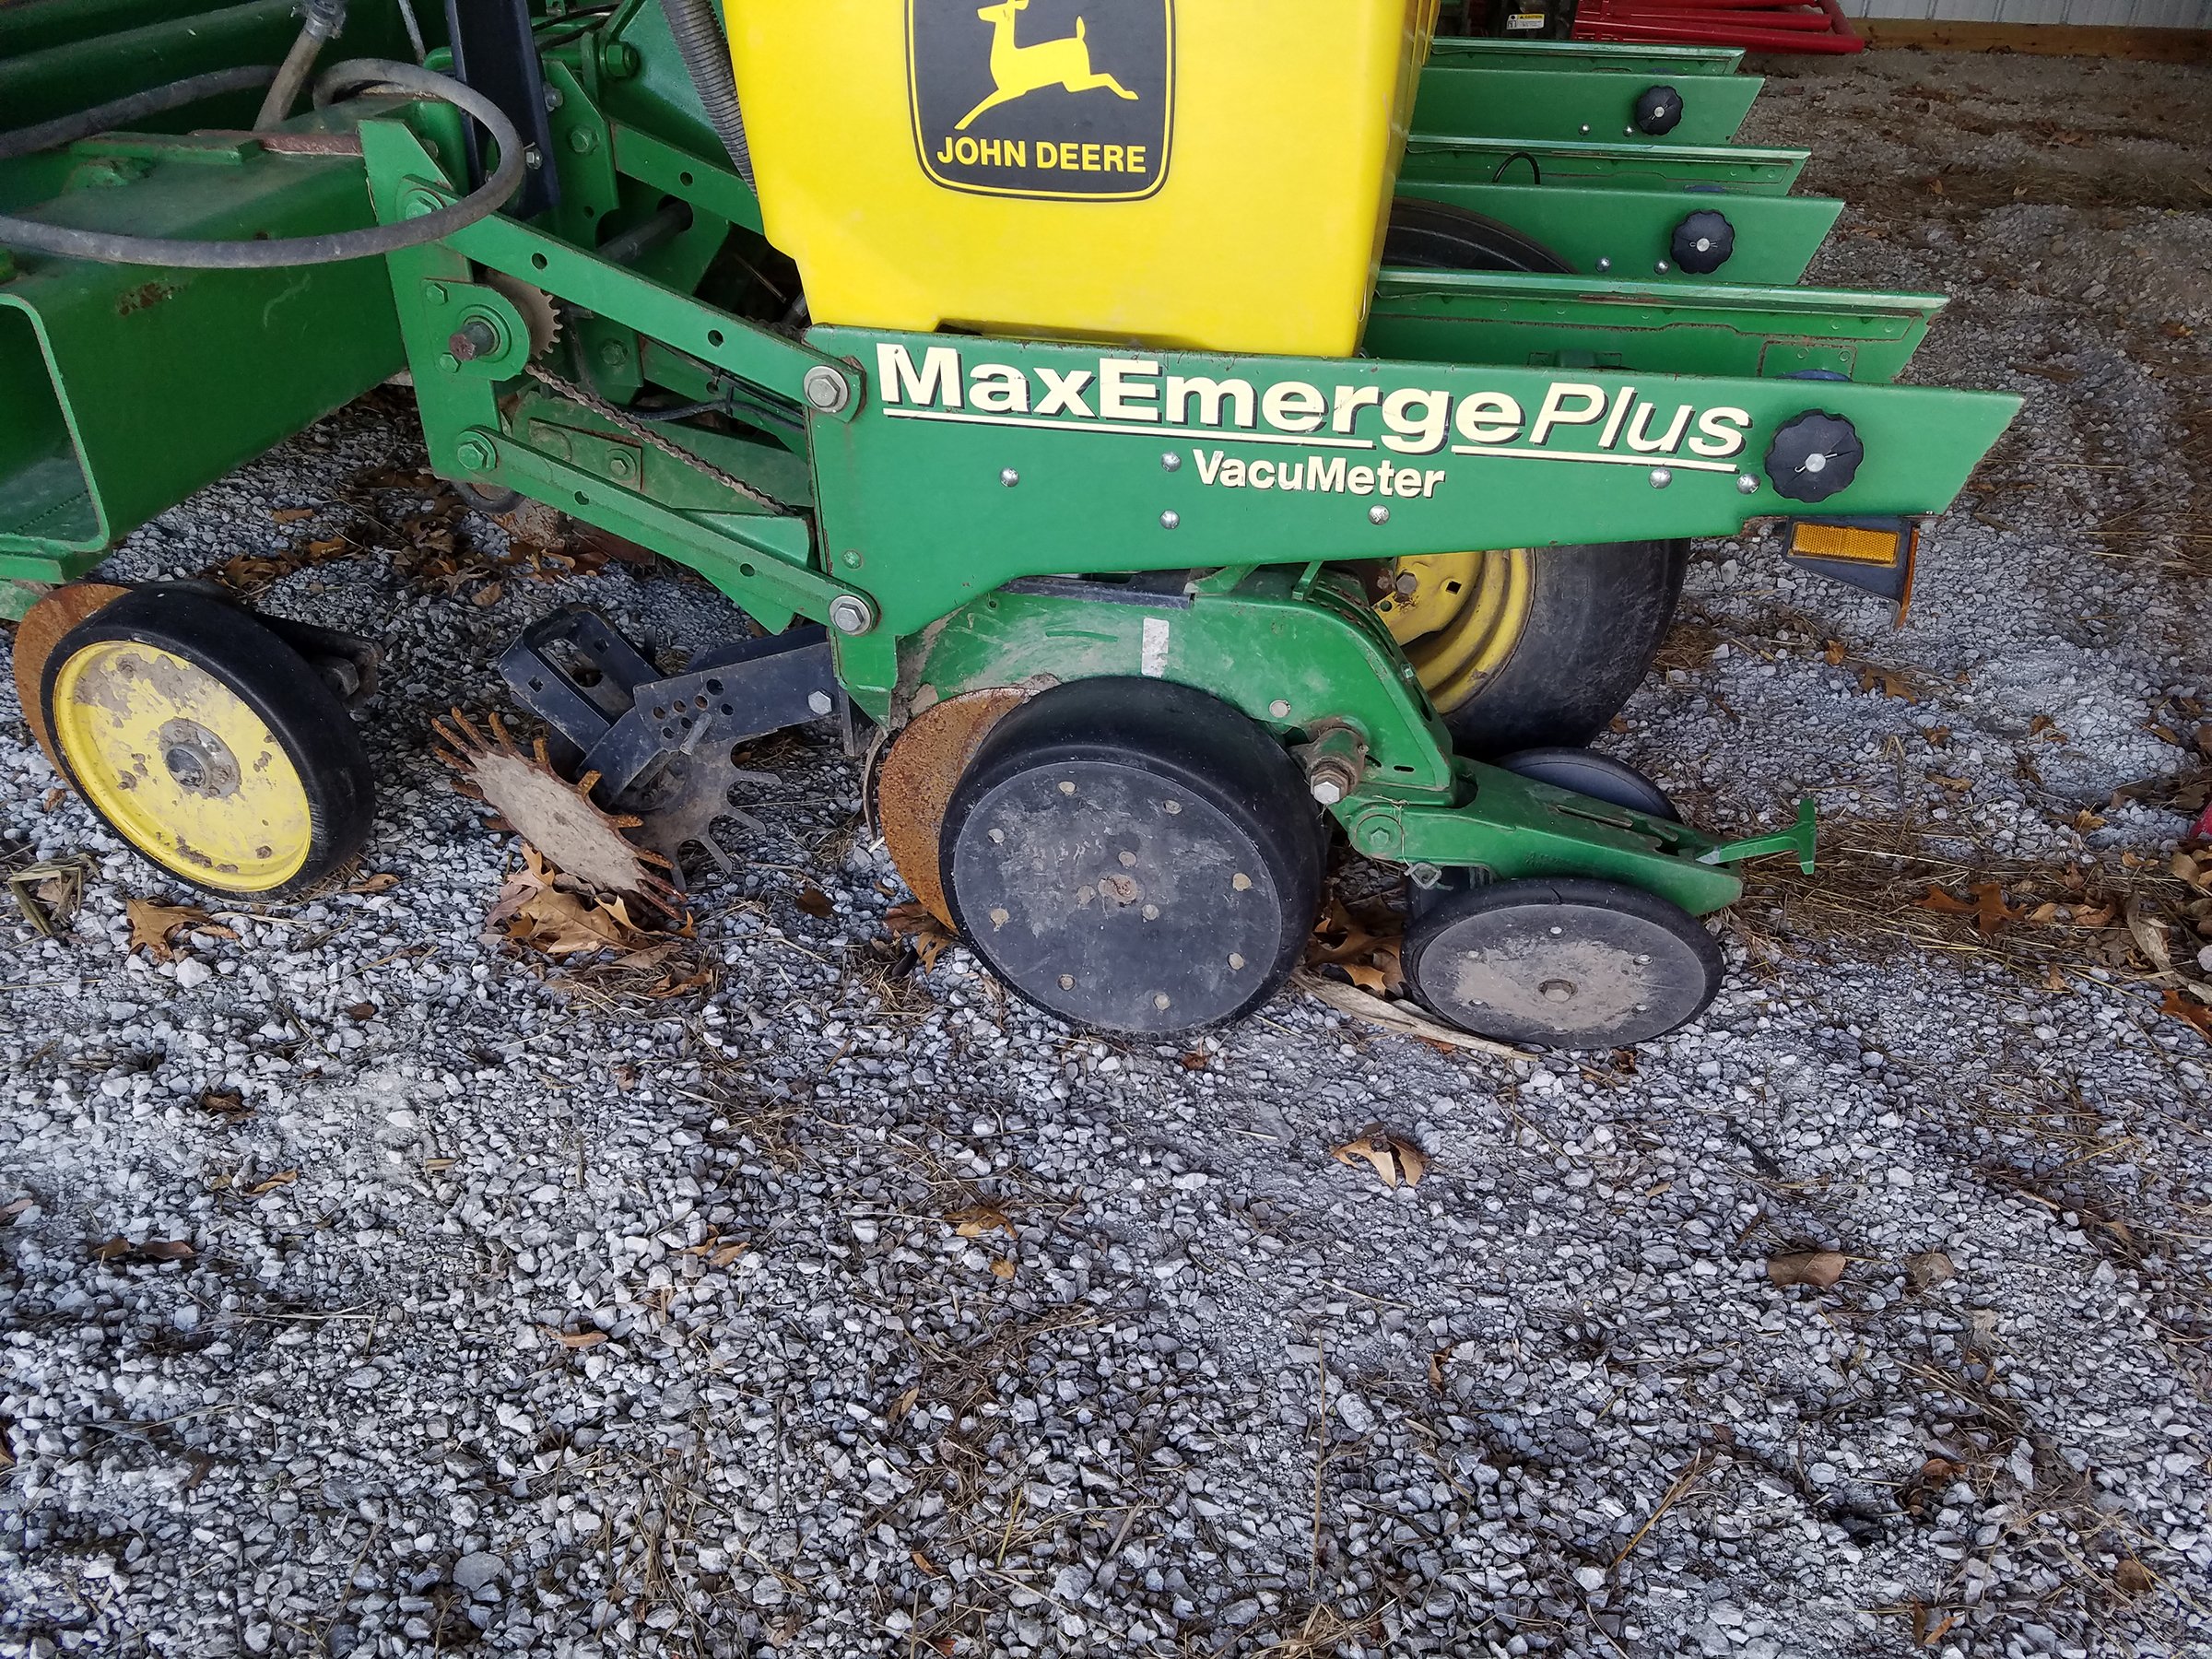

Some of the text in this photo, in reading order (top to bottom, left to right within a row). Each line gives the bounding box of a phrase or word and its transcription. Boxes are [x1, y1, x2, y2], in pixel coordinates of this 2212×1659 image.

[937, 136, 1147, 173] JOHN DEERE
[1193, 449, 1446, 499] VacuMeter
